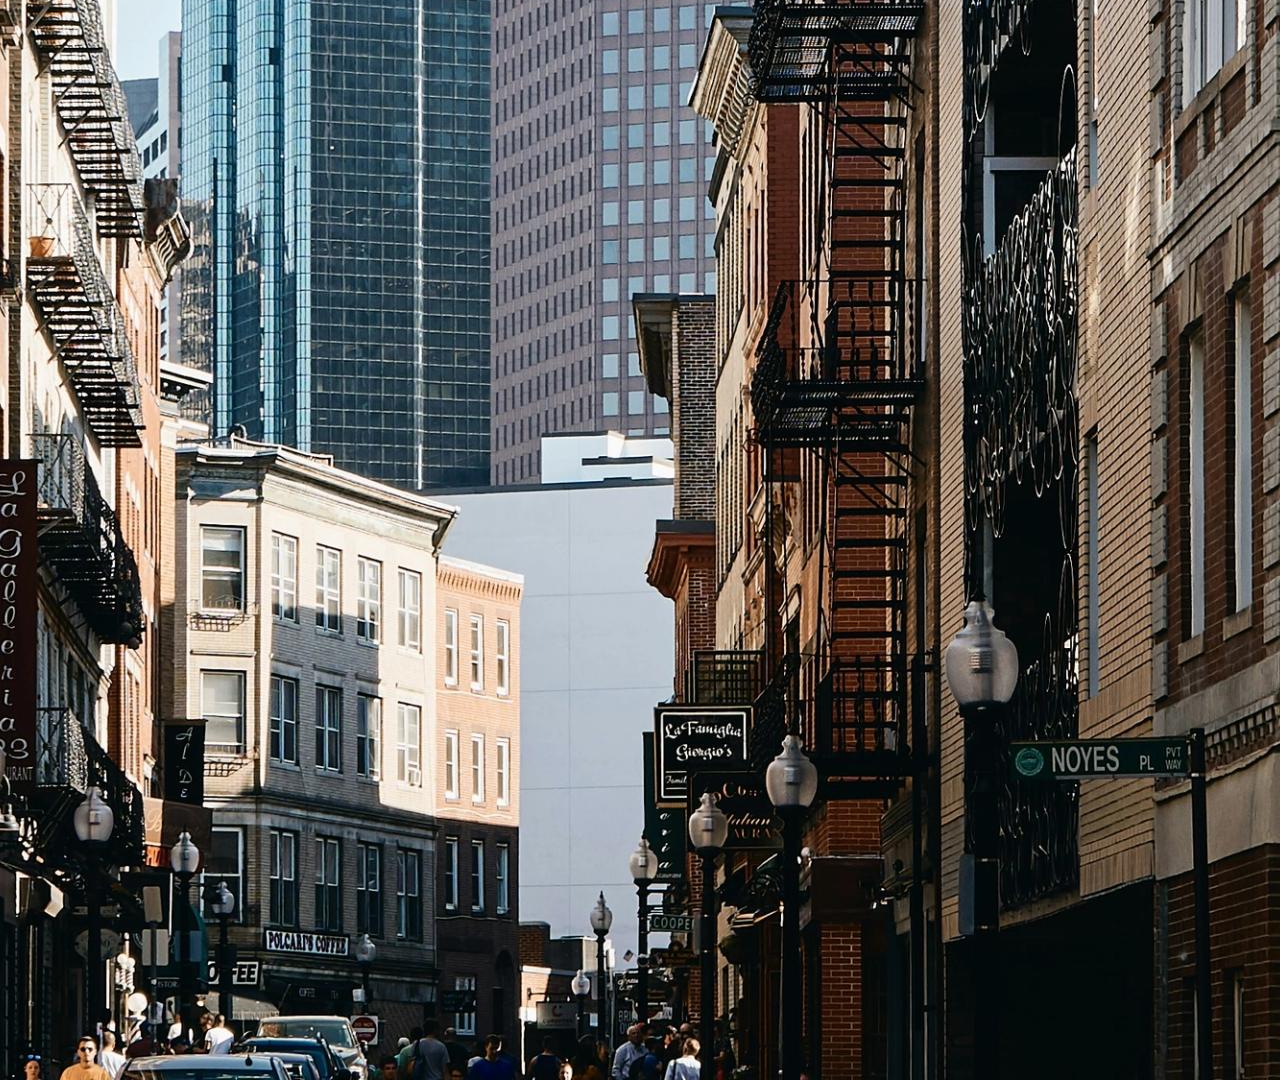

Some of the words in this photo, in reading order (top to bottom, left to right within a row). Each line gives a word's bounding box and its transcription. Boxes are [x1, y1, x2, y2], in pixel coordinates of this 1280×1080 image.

[682, 721, 743, 739] Famiglia
[676, 743, 733, 761] Giorgio's
[1052, 746, 1119, 772] NOYES
[1139, 755, 1154, 770] PL
[1165, 747, 1181, 758] PVT
[1165, 760, 1182, 770] WAY
[665, 776, 687, 785] Famil
[268, 931, 314, 951] POLCARI'S
[316, 936, 346, 954] COFFEE
